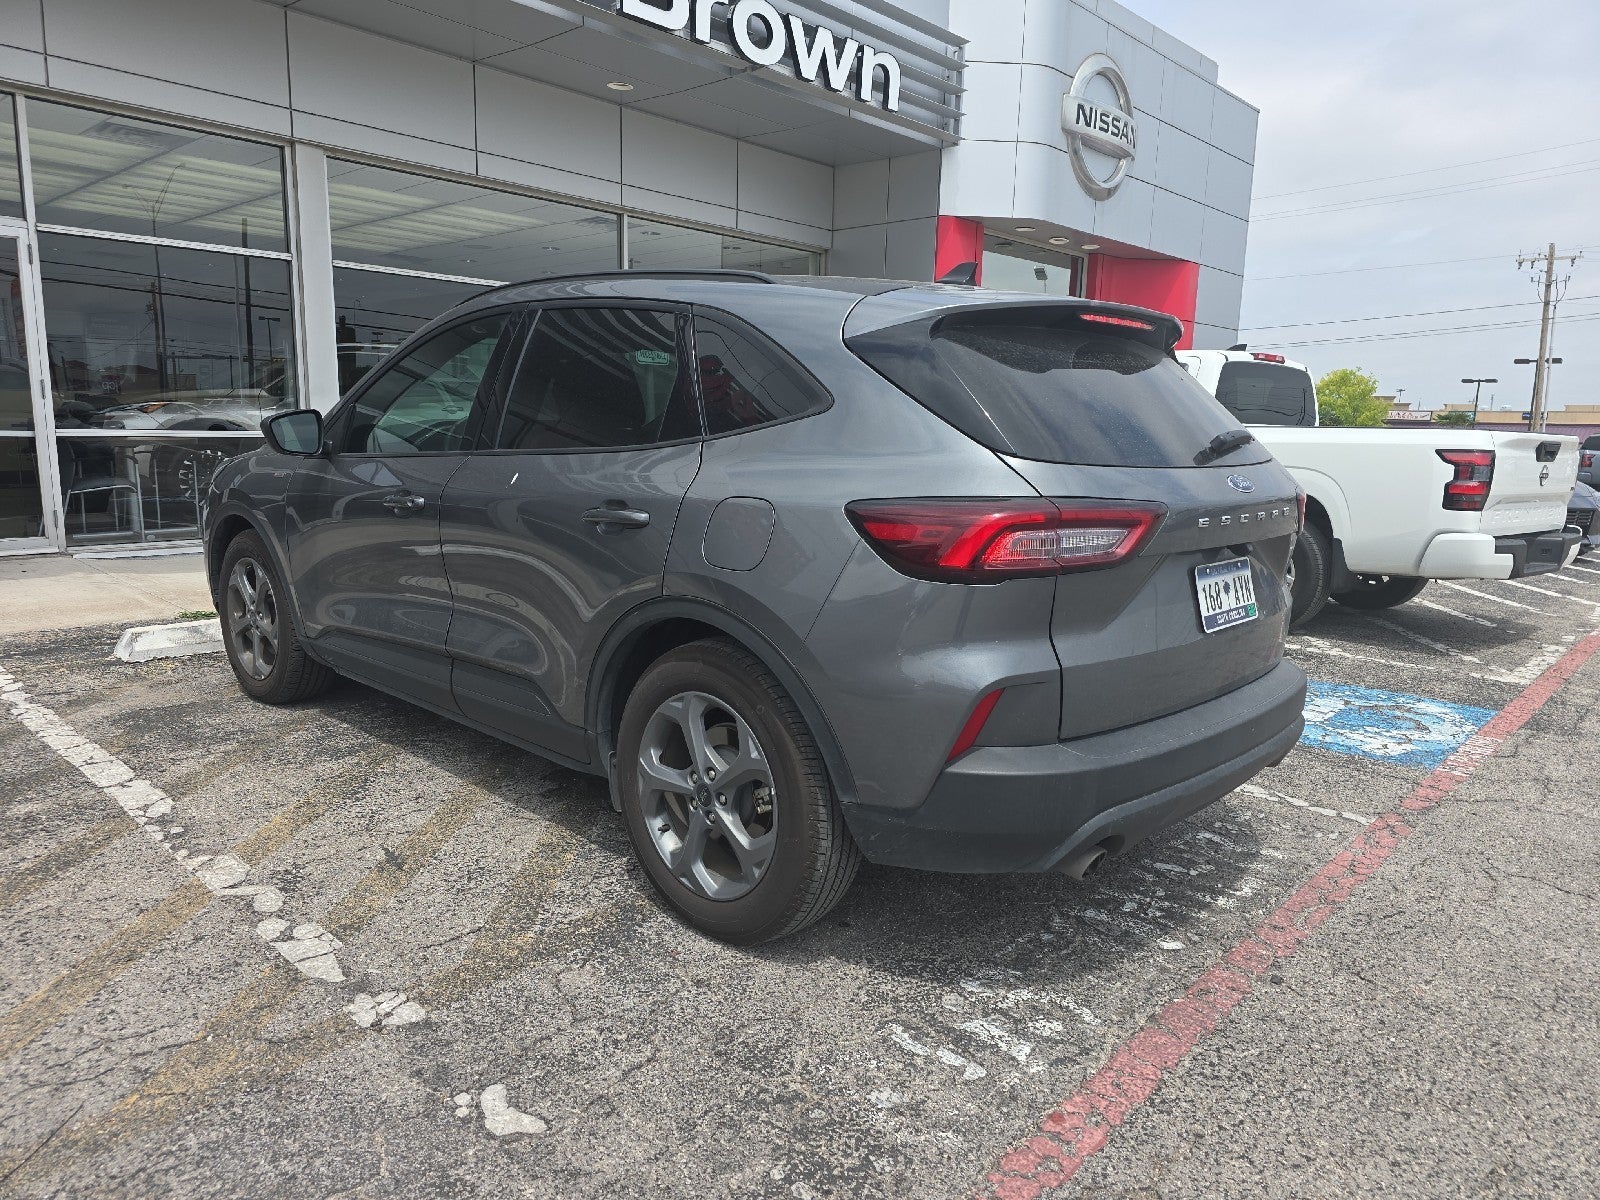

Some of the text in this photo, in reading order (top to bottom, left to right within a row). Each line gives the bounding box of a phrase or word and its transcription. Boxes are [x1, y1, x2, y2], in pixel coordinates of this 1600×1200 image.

[1075, 102, 1136, 149] NISSAN
[1197, 507, 1290, 528] ESCAPE
[1202, 582, 1223, 613] 168
